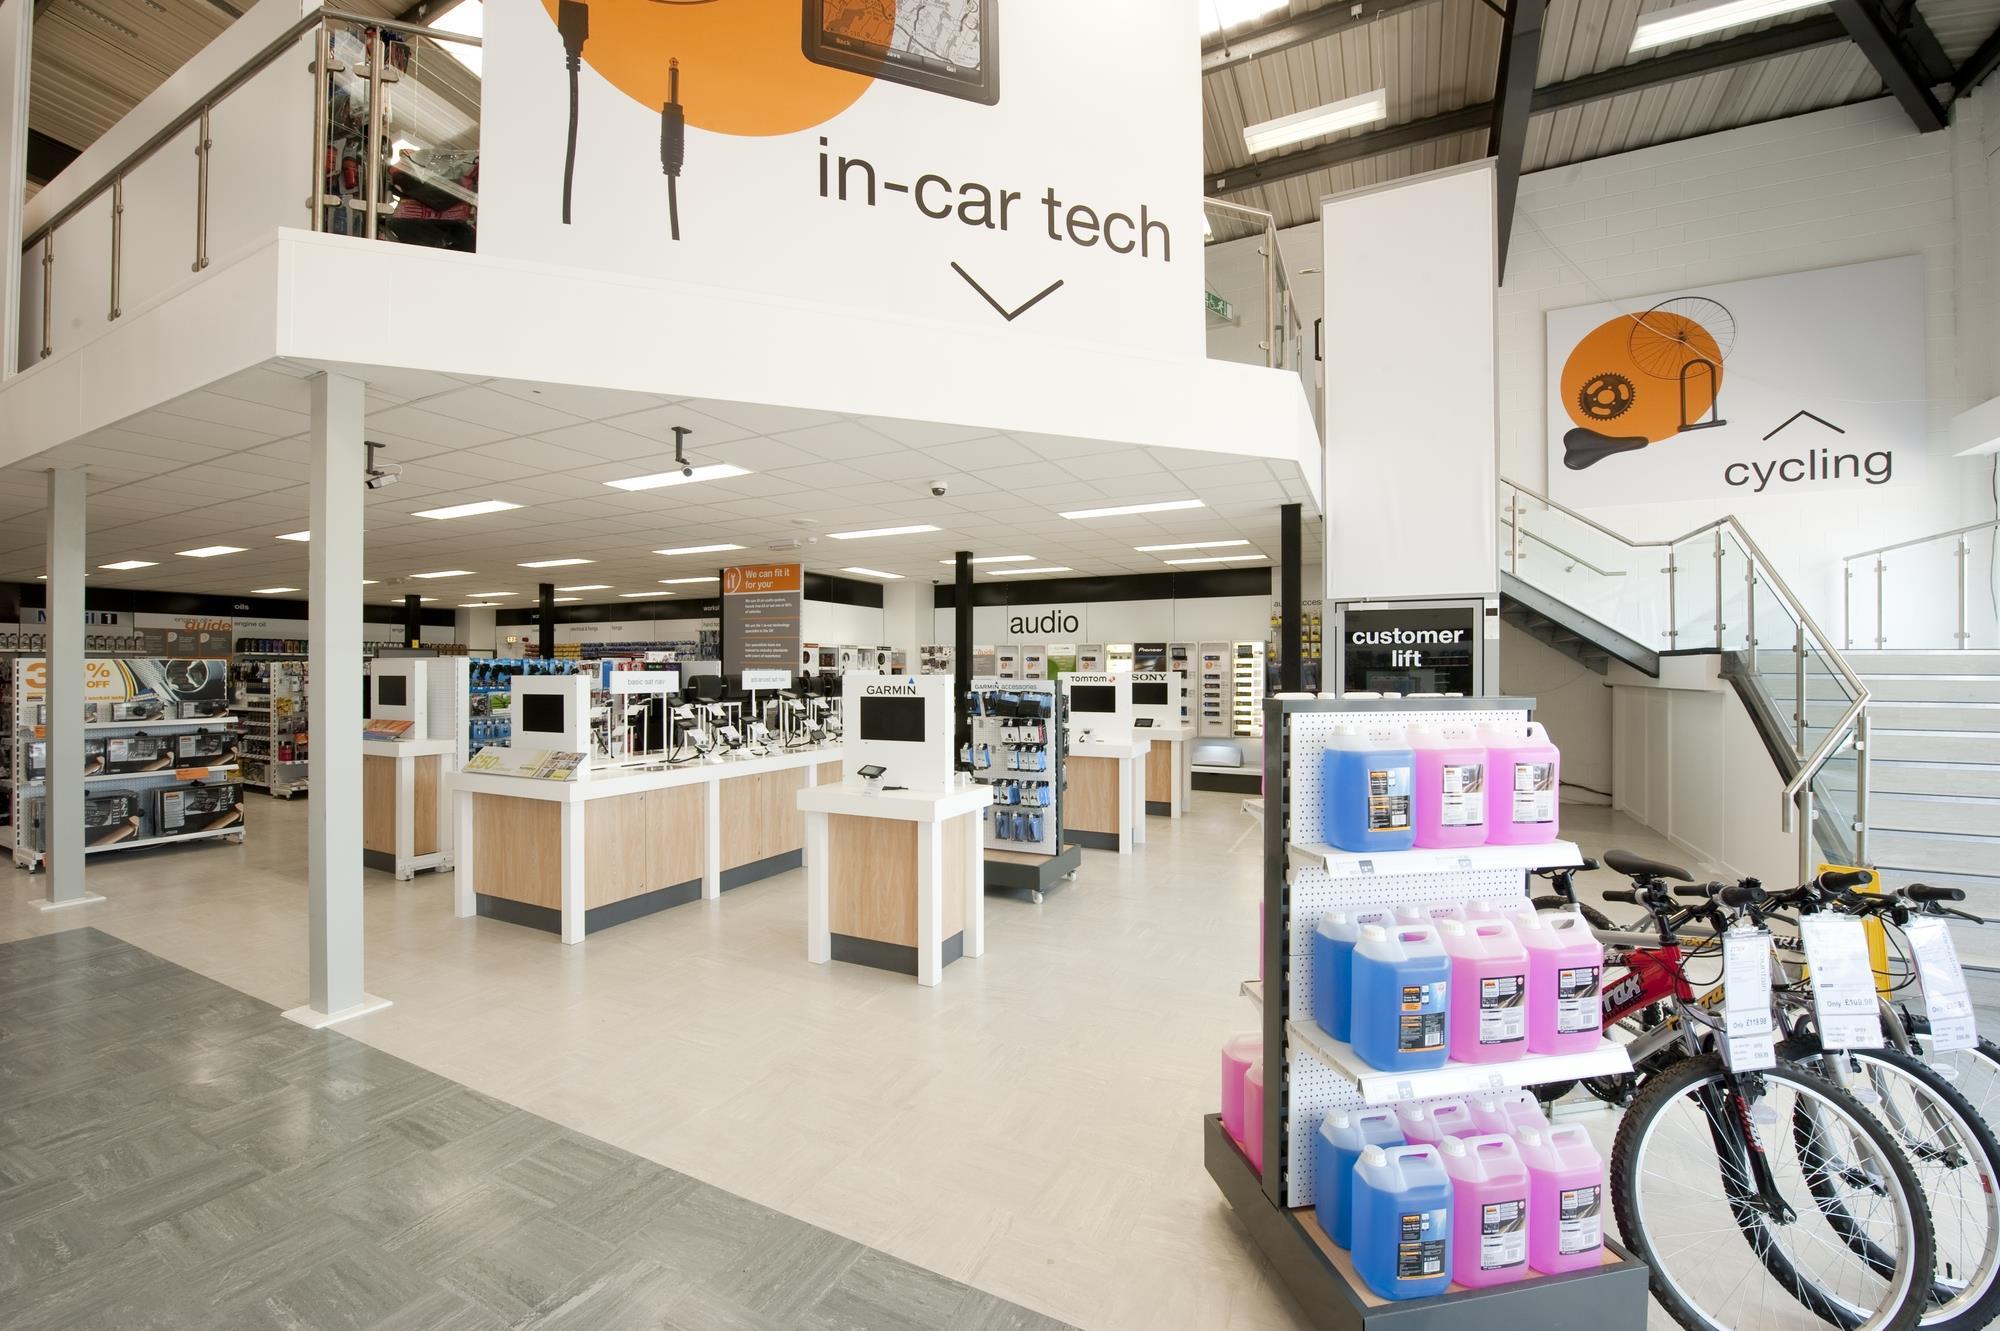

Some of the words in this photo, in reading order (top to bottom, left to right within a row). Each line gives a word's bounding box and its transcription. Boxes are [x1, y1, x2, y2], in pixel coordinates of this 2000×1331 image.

[818, 136, 1021, 231] in-car
[1041, 187, 1171, 262] tech
[1724, 448, 1892, 493] cycling
[745, 570, 757, 579] We
[757, 570, 773, 578] can
[774, 568, 783, 577] fit
[784, 568, 790, 576] it
[745, 580, 755, 589] for
[184, 619, 232, 634] guide
[1010, 609, 1079, 634] audio
[1352, 626, 1464, 645] customer
[1391, 650, 1422, 667] lift
[1132, 673, 1167, 681] SONY
[86, 680, 111, 689] OFF
[866, 685, 916, 695] GARMIN
[1826, 1000, 1841, 1008] Only
